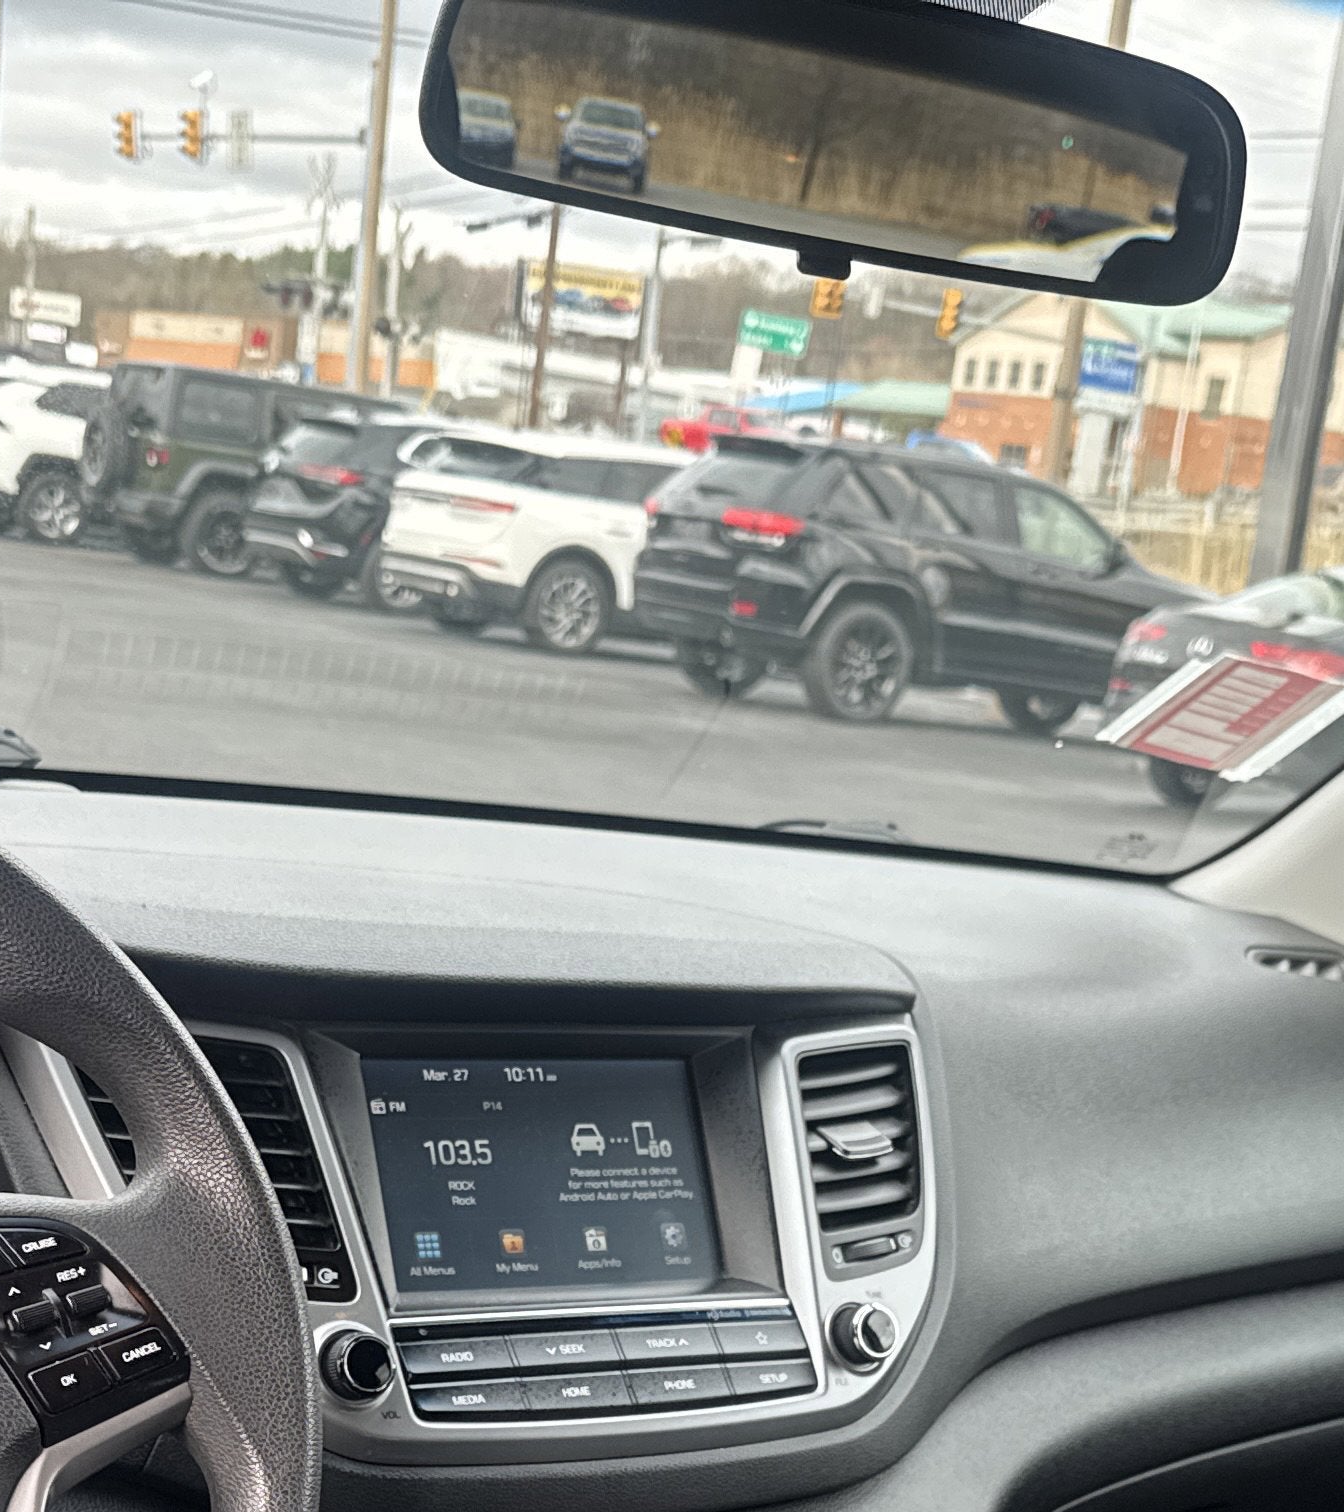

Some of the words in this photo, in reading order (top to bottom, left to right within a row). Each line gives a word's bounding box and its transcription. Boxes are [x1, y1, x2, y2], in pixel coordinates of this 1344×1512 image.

[422, 1069, 452, 1082] Mar.
[453, 1069, 469, 1081] 27
[504, 1067, 544, 1082] 10:11
[389, 1102, 406, 1113] FM
[482, 1101, 503, 1111] P14
[423, 1139, 492, 1166] 103.5
[570, 1168, 601, 1178] Please
[602, 1167, 639, 1177] connect
[641, 1167, 648, 1176] a
[649, 1166, 678, 1175] device
[448, 1180, 476, 1191] ROCK
[568, 1180, 582, 1189] for
[584, 1180, 609, 1189] more
[610, 1179, 649, 1189] features
[650, 1178, 671, 1188] such
[673, 1178, 684, 1187] as
[452, 1196, 477, 1206] Rock
[559, 1192, 595, 1202] Android
[597, 1192, 619, 1201] Auto
[620, 1192, 631, 1201] or
[632, 1190, 657, 1201] Apple
[658, 1189, 694, 1200] CarPlay
[21, 1236, 58, 1254] CRUISE
[664, 1256, 692, 1267] Setup
[410, 1267, 422, 1277] All
[423, 1266, 456, 1276] Menus
[496, 1263, 511, 1275] My
[512, 1262, 539, 1272] Menu
[646, 1337, 678, 1349] TRACK
[121, 1341, 162, 1363] CANCEL
[559, 1344, 586, 1355] SEEK
[440, 1352, 475, 1363] RADIO
[60, 1373, 78, 1388] OK
[663, 1378, 696, 1391] PHONE
[759, 1373, 788, 1384] SETUP
[561, 1385, 592, 1398] HOME
[452, 1393, 486, 1406] MEDIA
[381, 1410, 402, 1420] VOL
